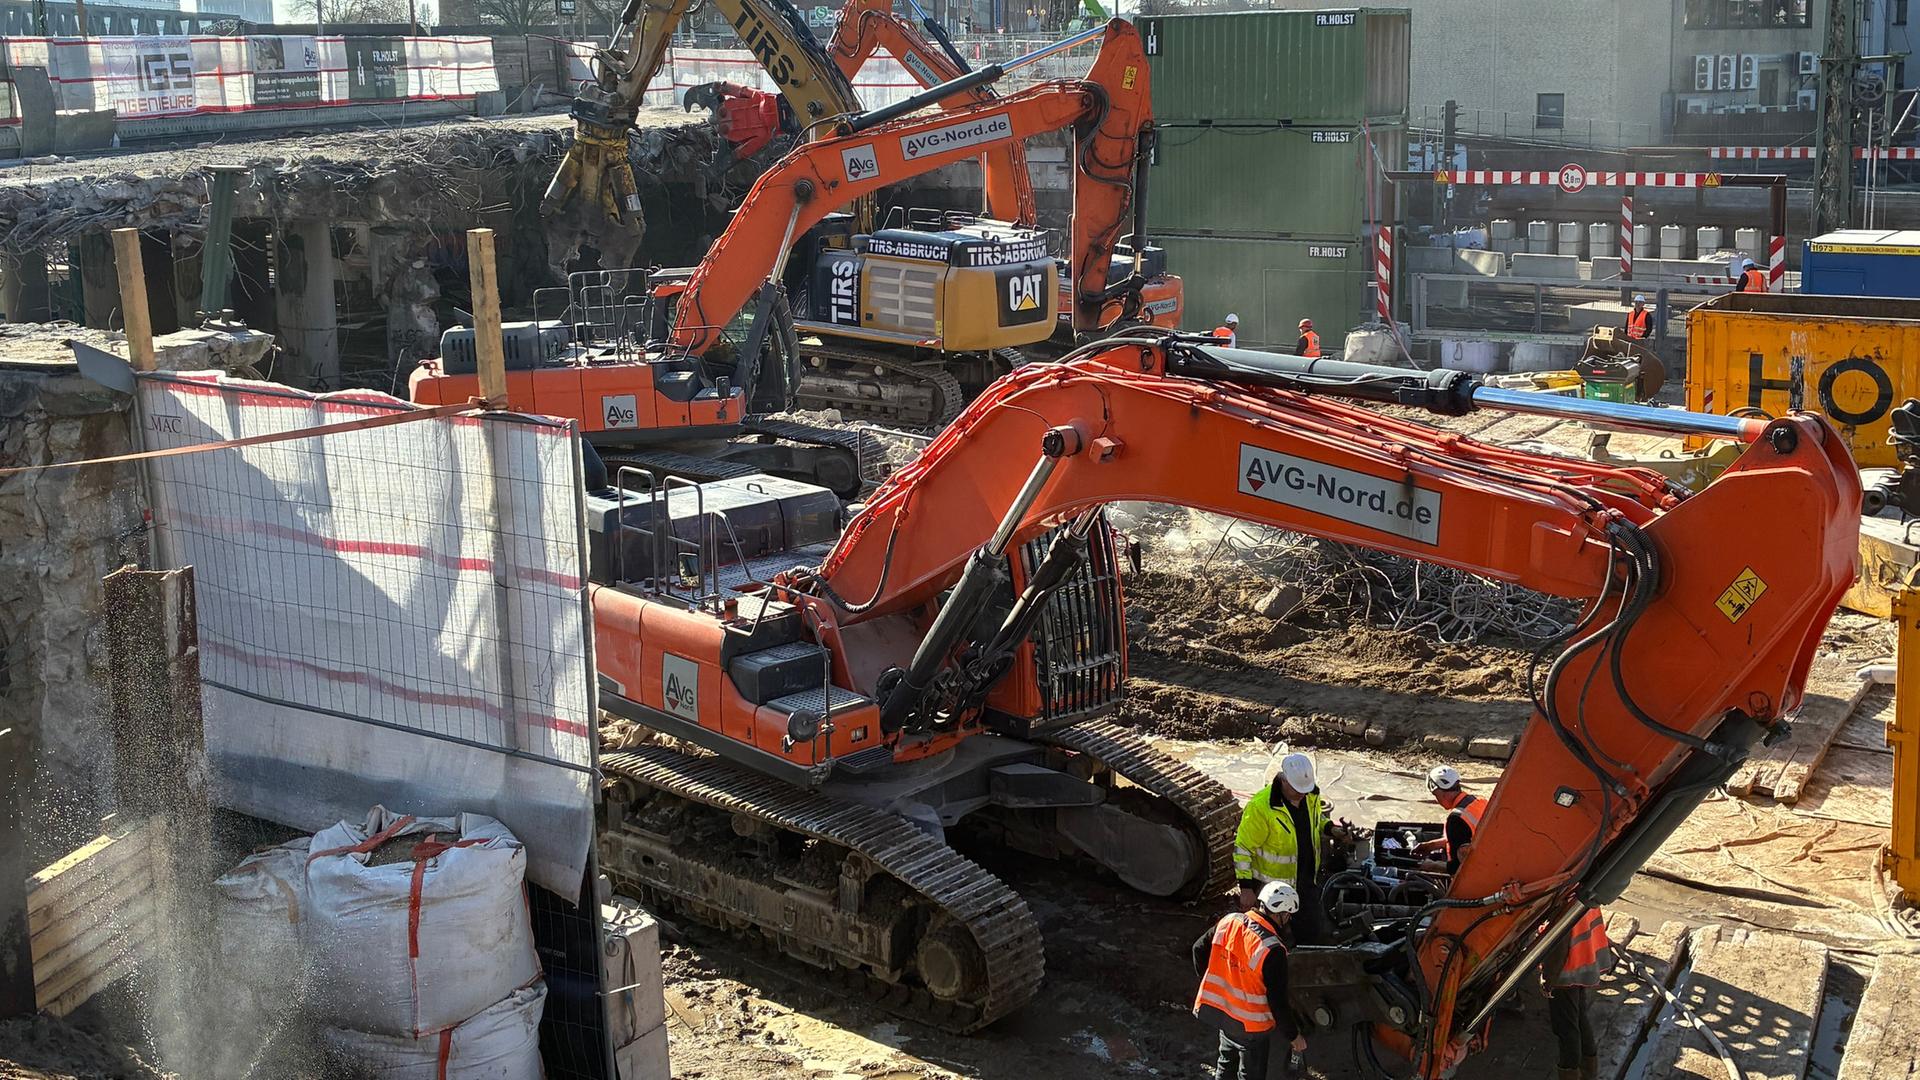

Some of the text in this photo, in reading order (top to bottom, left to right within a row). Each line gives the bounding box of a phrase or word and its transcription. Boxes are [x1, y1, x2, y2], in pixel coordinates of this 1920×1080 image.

[1316, 14, 1355, 25] FR.HOLST
[136, 53, 192, 92] IGS
[906, 120, 1008, 152] AVG-Nord.de
[1312, 132, 1350, 143] FR.HOLST
[849, 157, 875, 175] AVG
[868, 238, 949, 261] TIRS-ABBRUCH
[1309, 246, 1347, 258] FR.HOLST
[831, 260, 854, 323] TIRS
[1009, 273, 1042, 312] CAT
[607, 405, 634, 421] AVG
[1245, 457, 1432, 525] AVG-Nord.de
[665, 673, 694, 705] AVG
